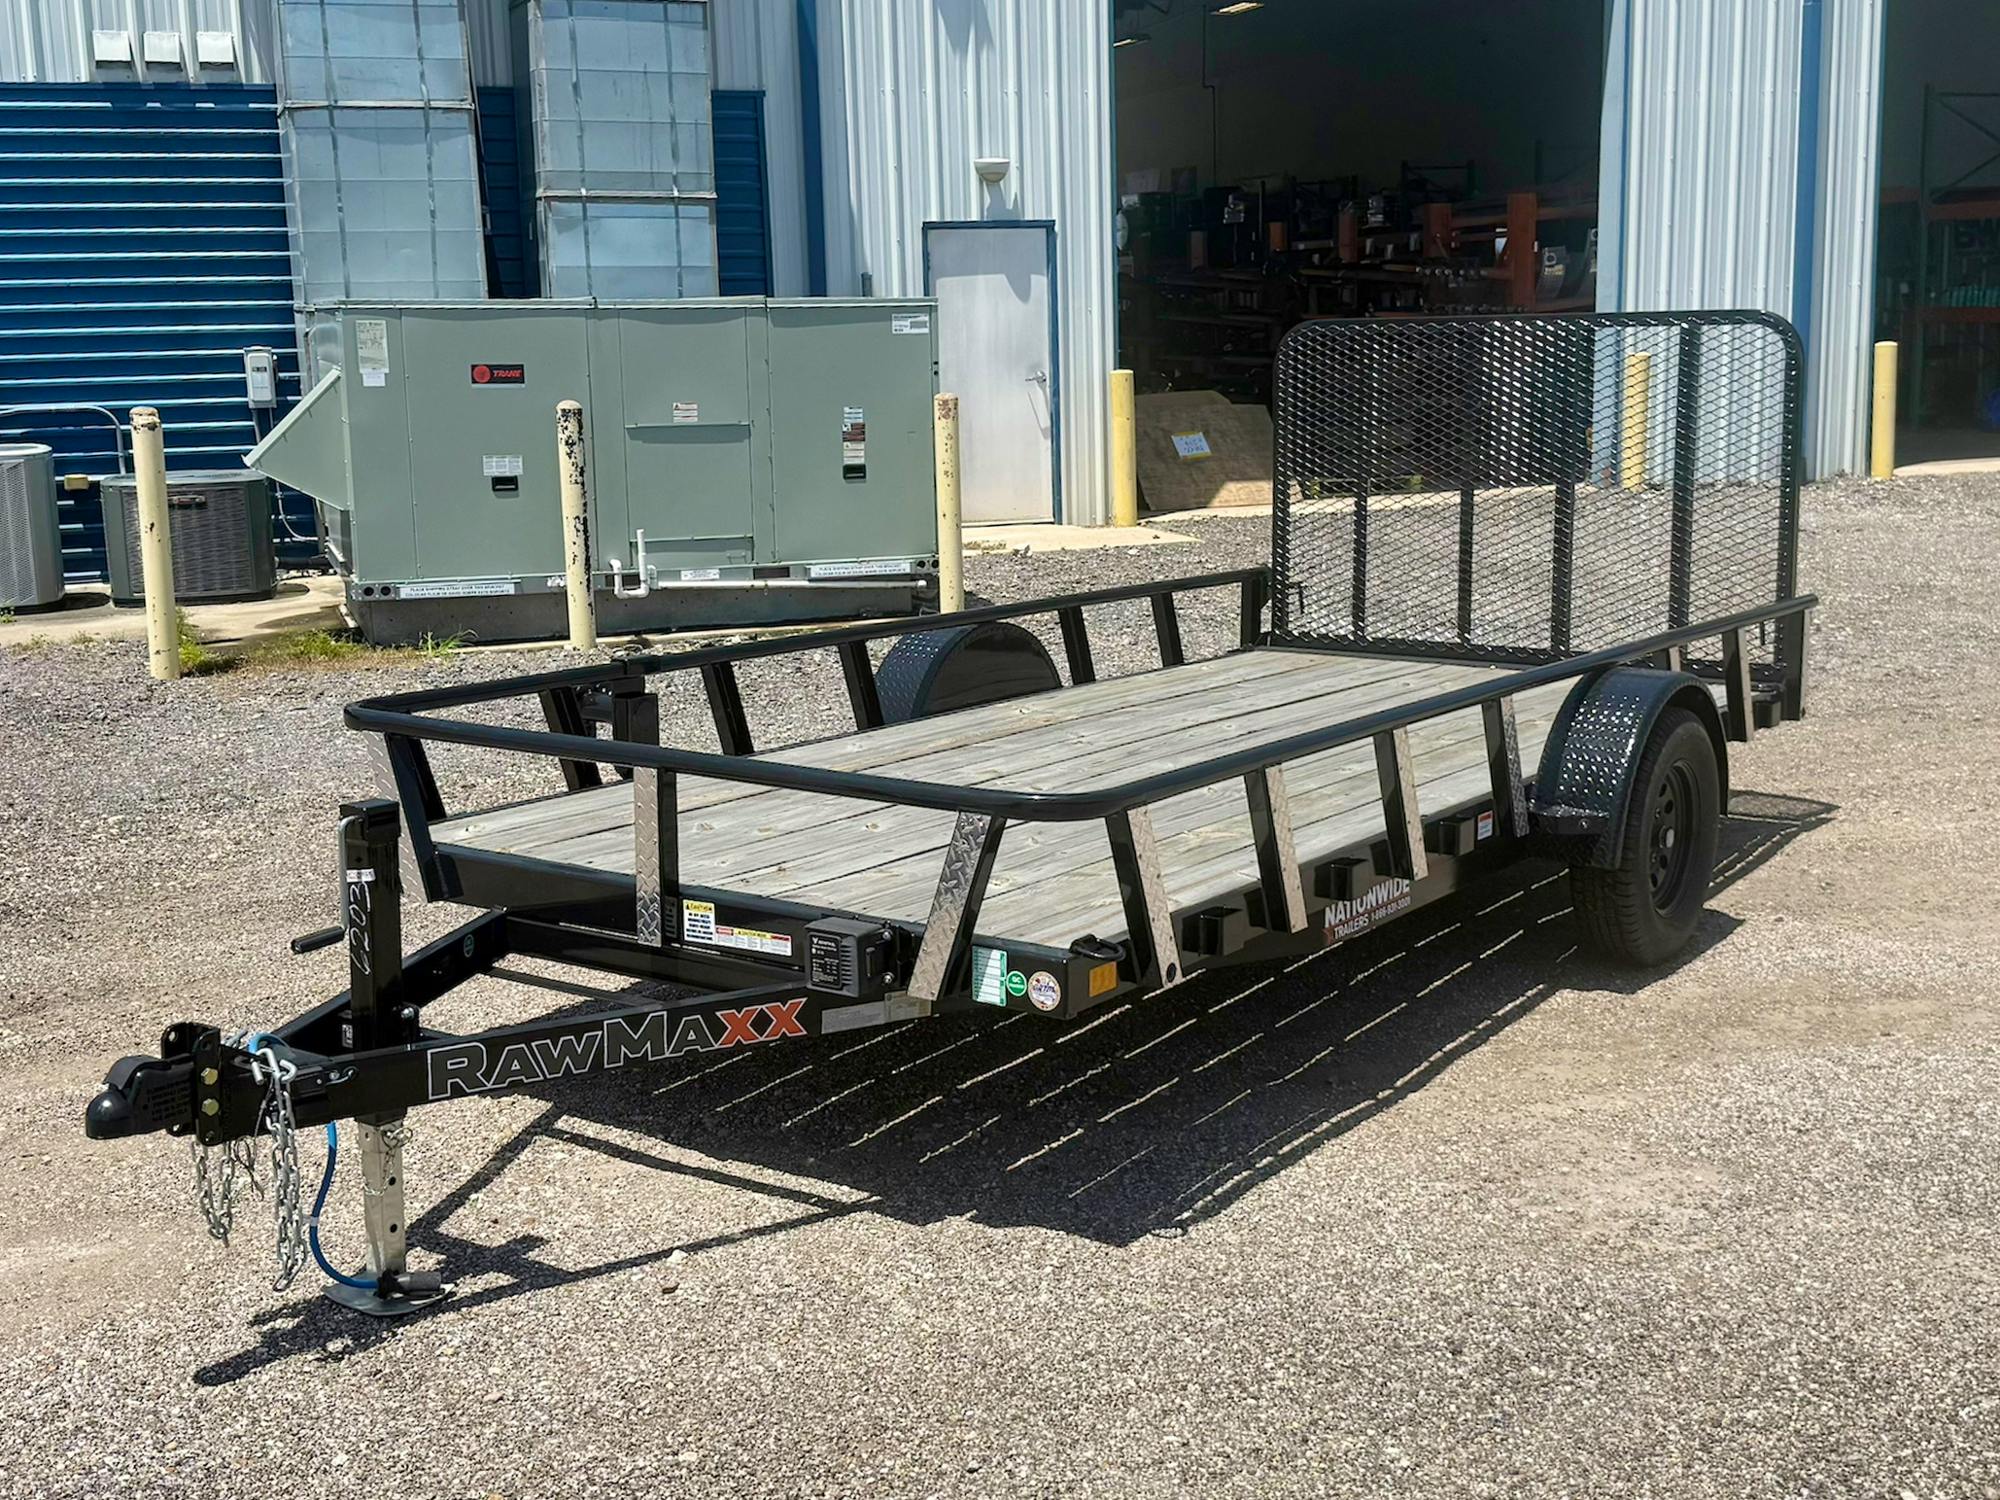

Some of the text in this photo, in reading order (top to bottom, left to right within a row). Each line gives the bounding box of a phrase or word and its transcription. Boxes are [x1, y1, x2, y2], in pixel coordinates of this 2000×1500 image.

[493, 369, 522, 378] TRANE
[1325, 877, 1410, 928] NATIONWIDE
[349, 881, 371, 975] 6203
[1334, 913, 1369, 939] TRAILERS
